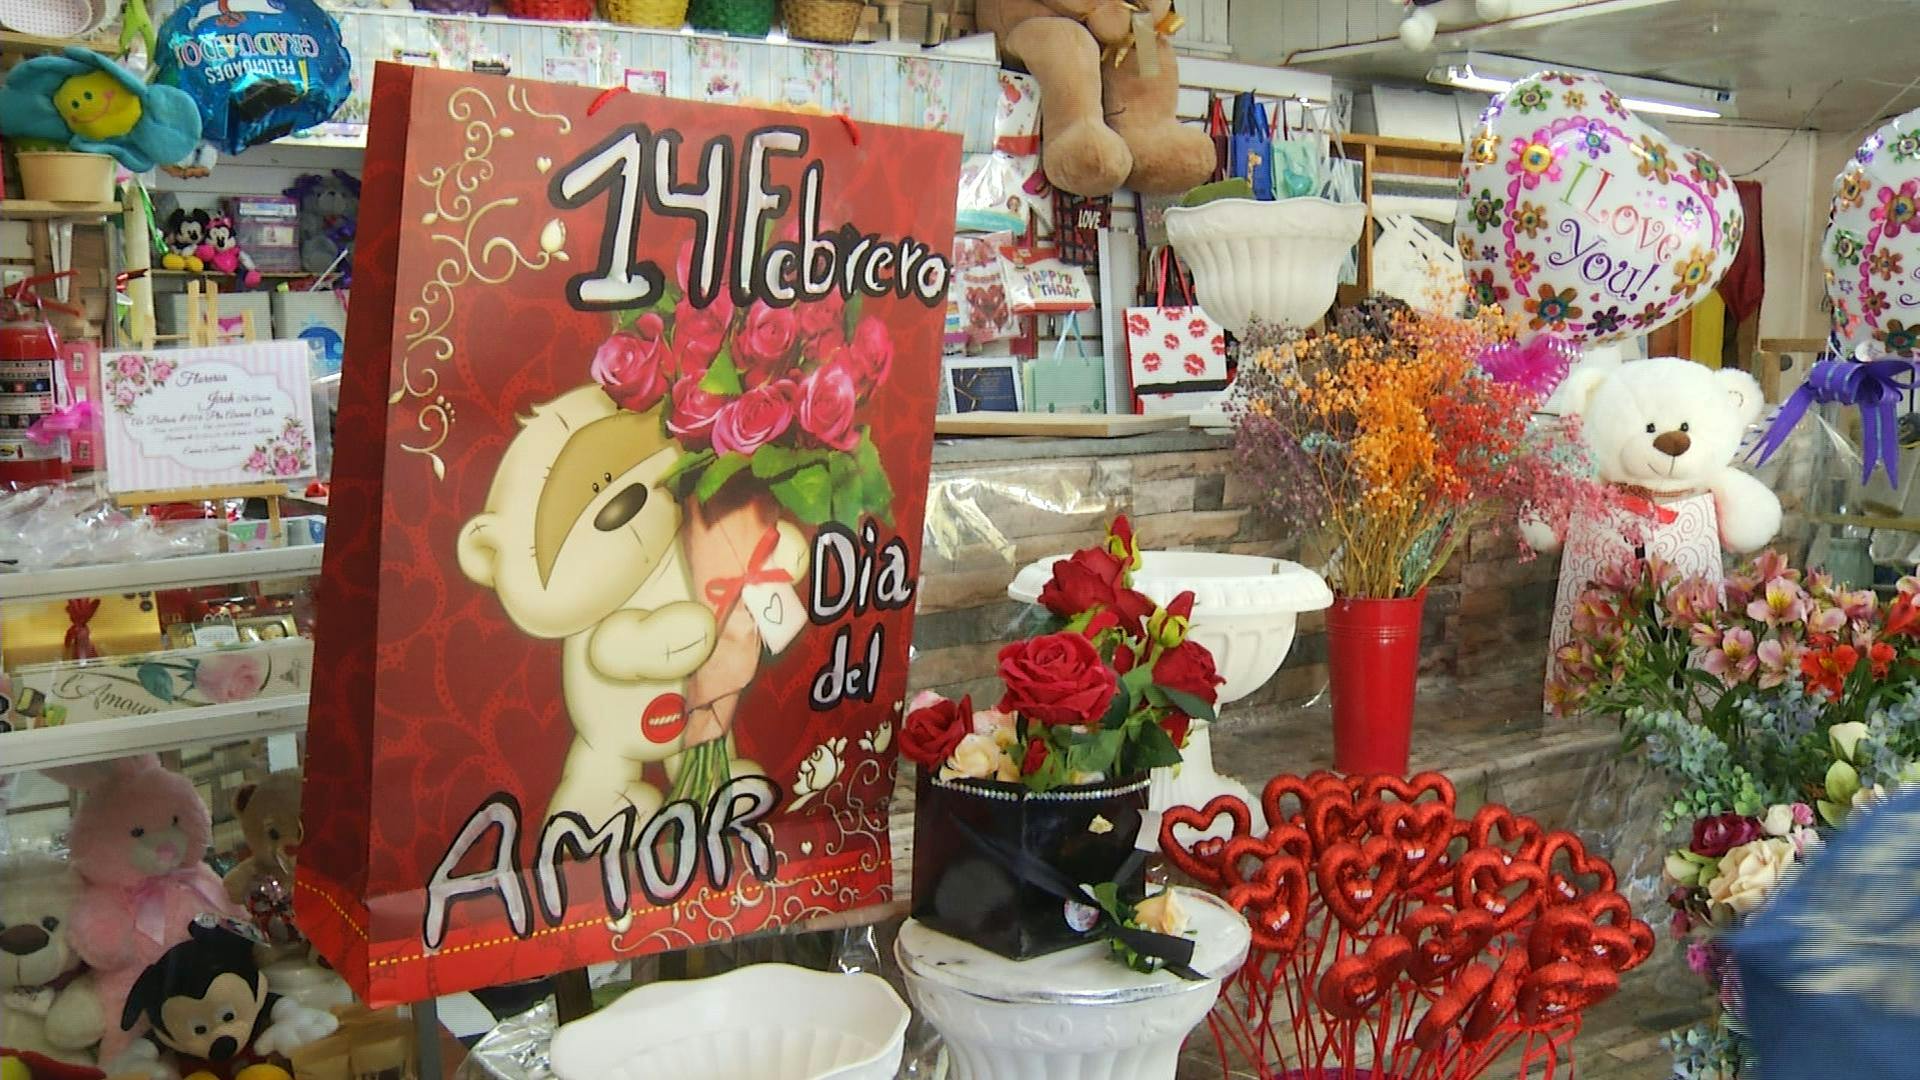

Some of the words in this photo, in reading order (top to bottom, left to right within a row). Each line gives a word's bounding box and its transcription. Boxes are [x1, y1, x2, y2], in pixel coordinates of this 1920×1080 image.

[548, 122, 734, 310] 14
[729, 126, 952, 308] Febrero
[1078, 209, 1101, 229] LOVE
[1560, 161, 1592, 206] I
[809, 516, 914, 625] Dia
[809, 622, 885, 711] del
[422, 775, 783, 950] AMOR
